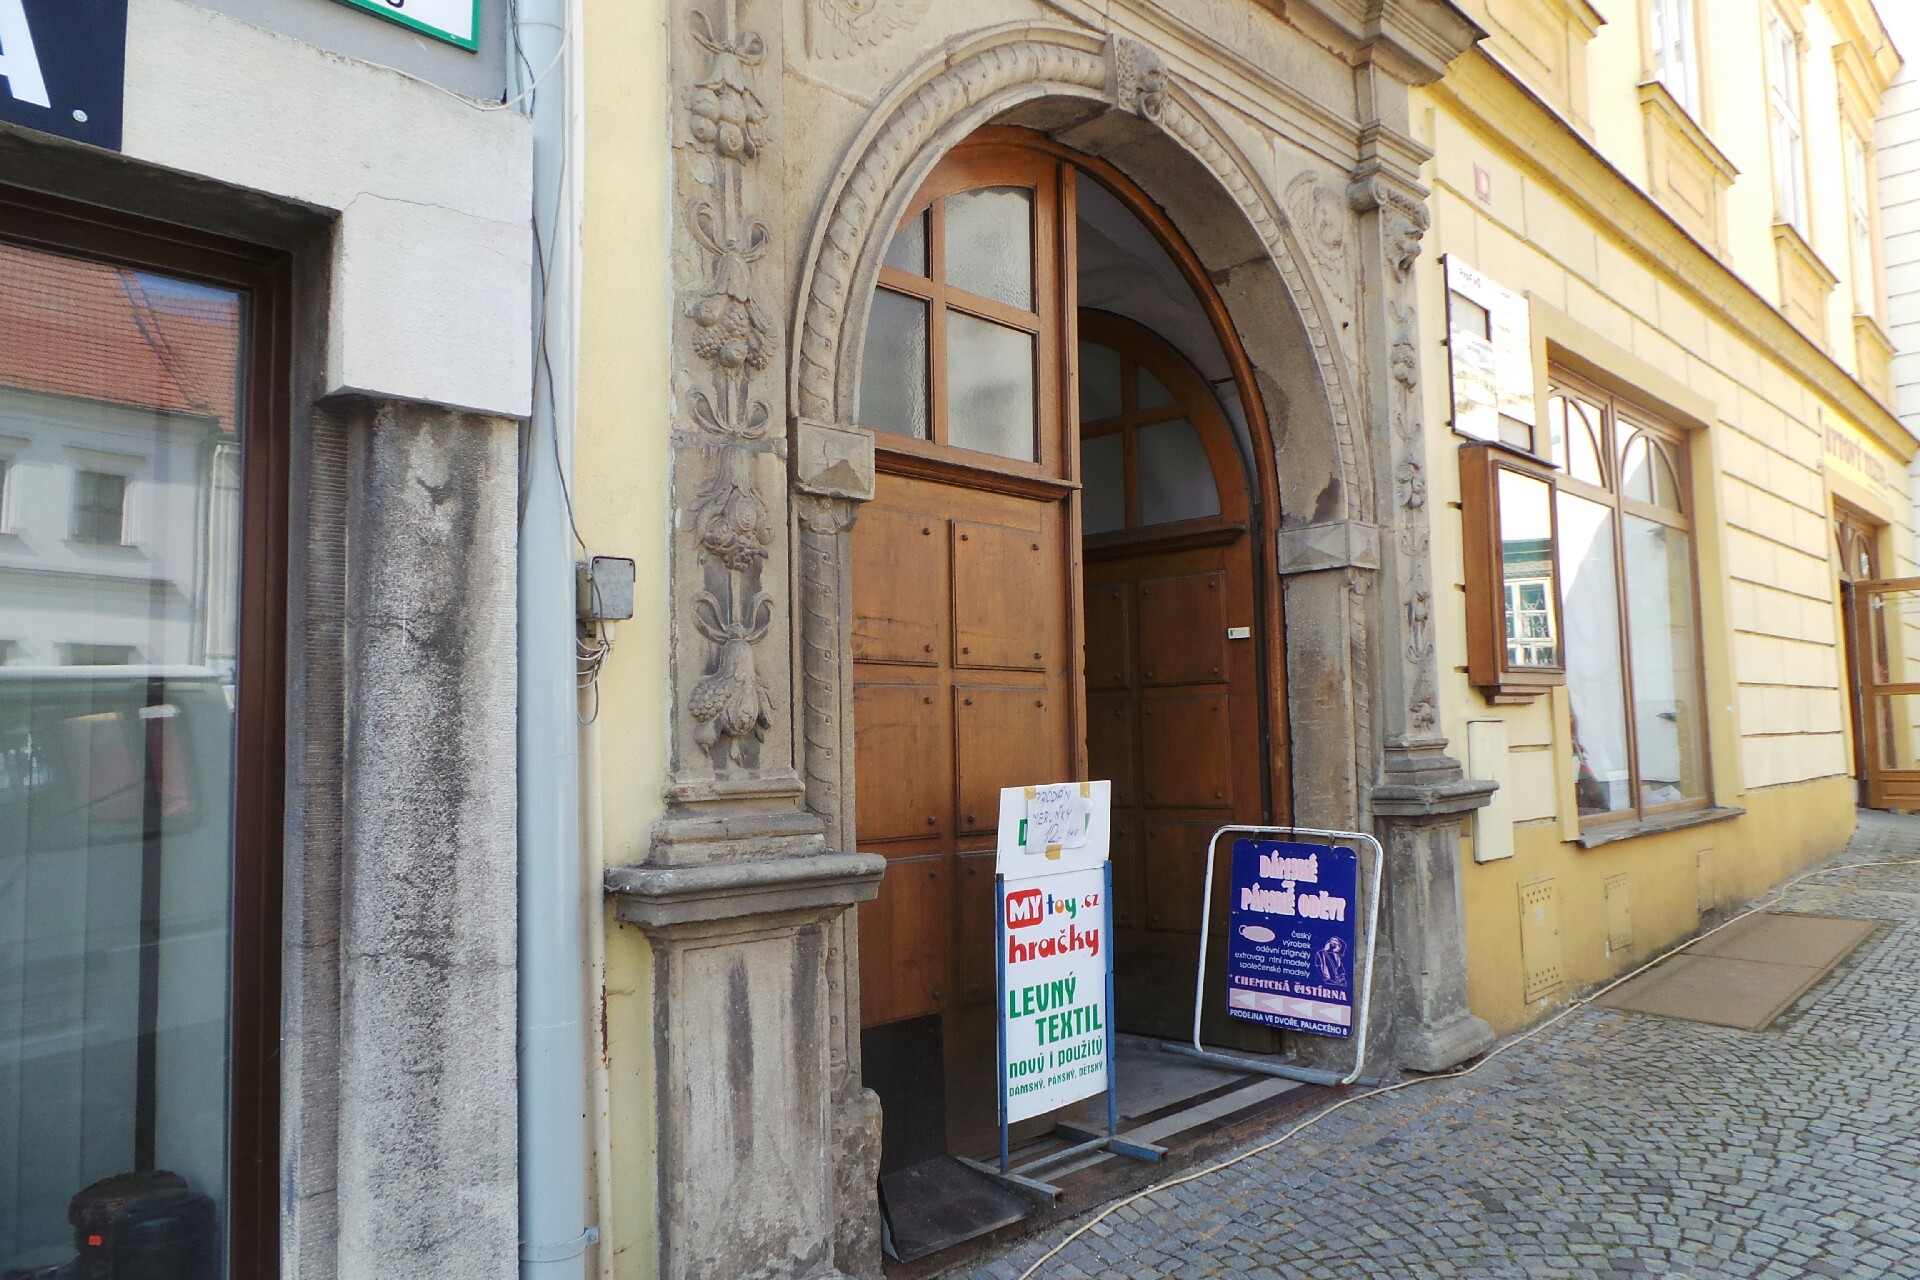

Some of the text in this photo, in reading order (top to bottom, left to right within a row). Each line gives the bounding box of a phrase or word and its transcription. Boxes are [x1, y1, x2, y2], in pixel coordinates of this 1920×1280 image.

[1008, 924, 1099, 964] hračky
[1282, 939, 1310, 949] výrobek
[1291, 930, 1311, 940] český
[1255, 945, 1310, 959] oděvní originály
[1239, 961, 1310, 979] společenské modely
[1283, 958, 1310, 969] modely
[1009, 971, 1077, 1019] LEVNÝ
[1234, 975, 1347, 1000] CHEMICKÁ ČISTÍRNA
[1035, 1003, 1103, 1046] TEXTIL
[1229, 1008, 1263, 1021] PRODEJNA
[1264, 1014, 1274, 1023] VE
[1300, 1020, 1341, 1034] PALACKÉHO
